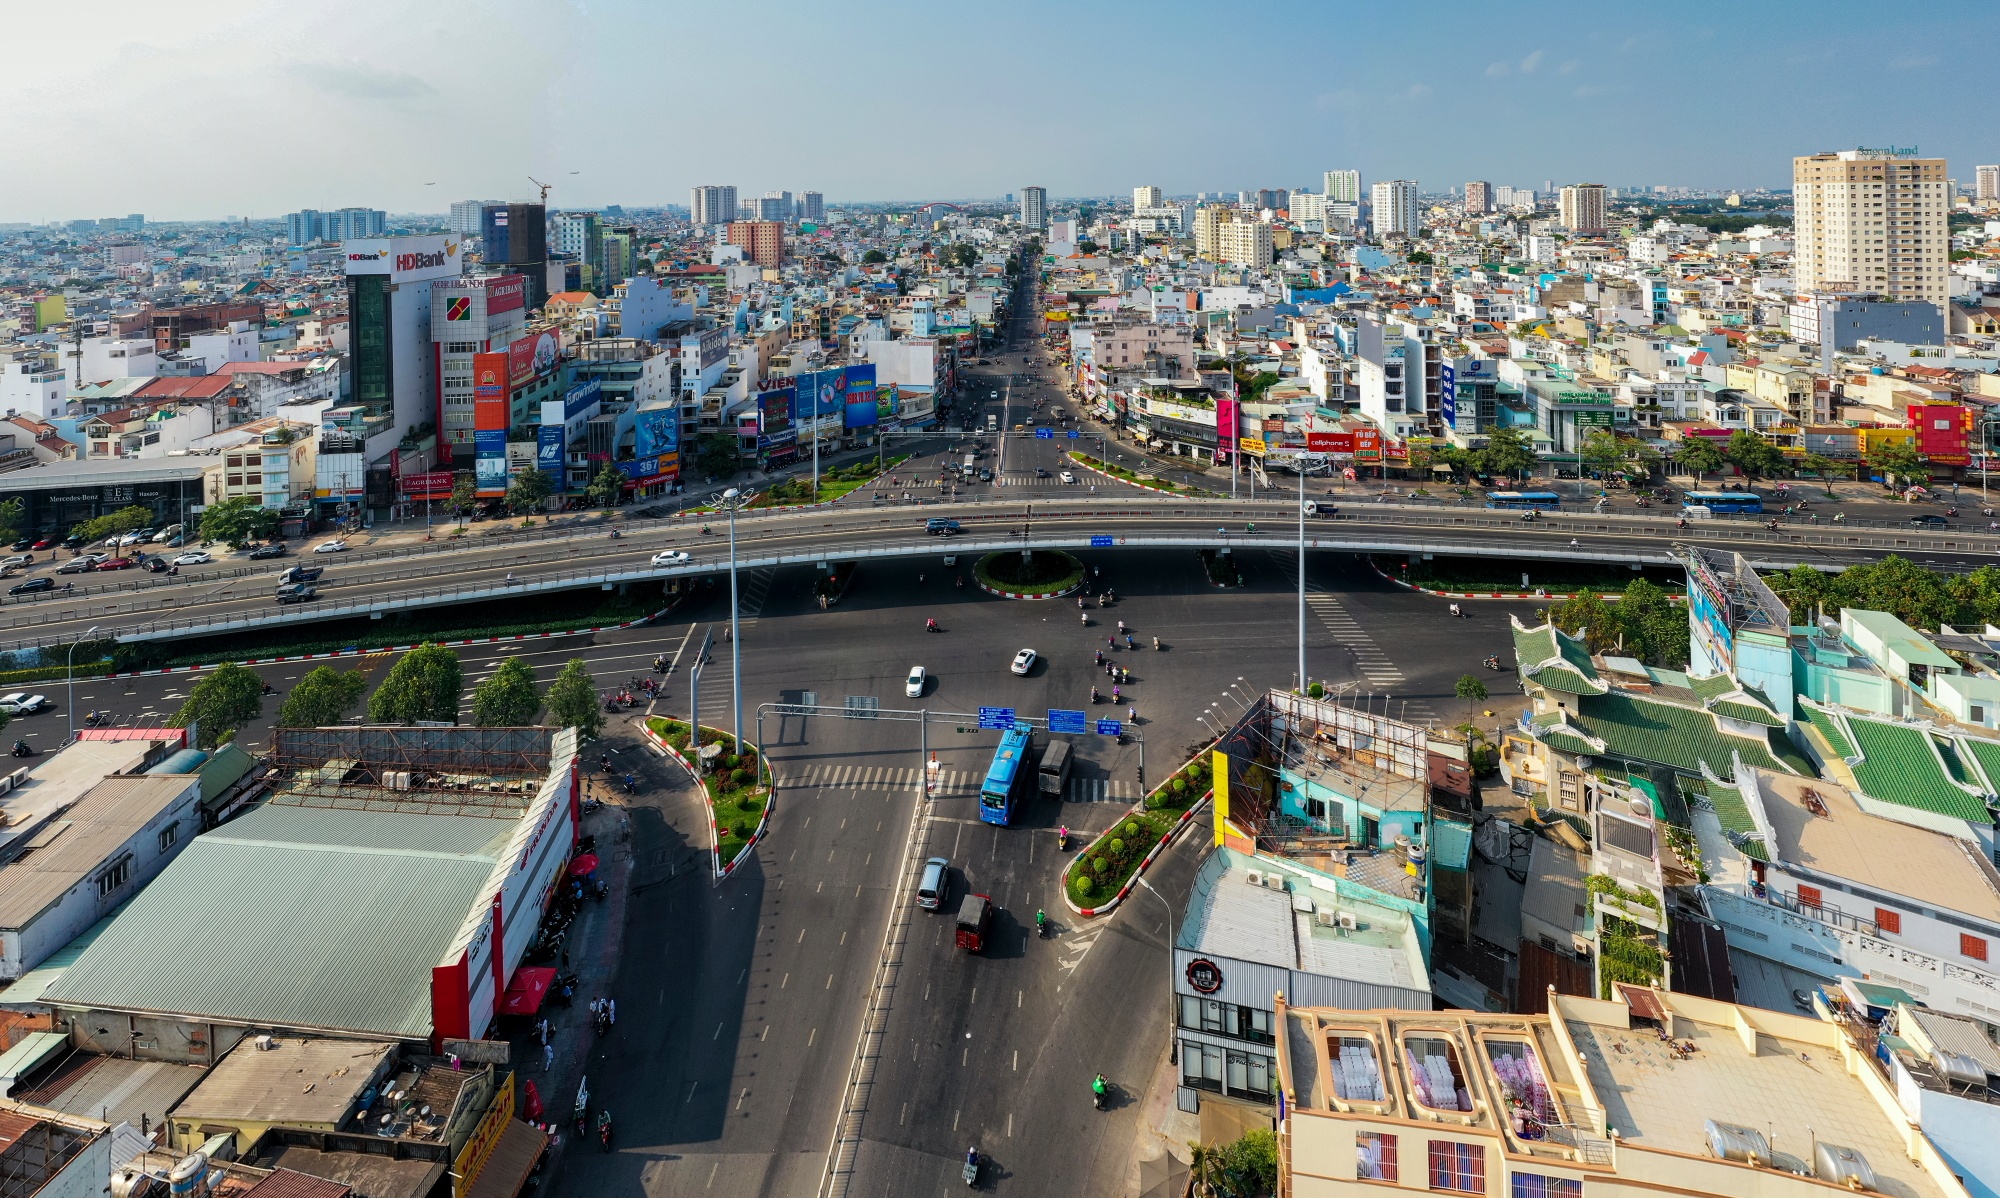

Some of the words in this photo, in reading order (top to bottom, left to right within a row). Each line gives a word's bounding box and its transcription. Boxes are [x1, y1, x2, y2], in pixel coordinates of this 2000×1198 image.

[1891, 145, 1918, 155] Land
[349, 253, 379, 261] HDBank
[396, 250, 445, 272] HDBank
[494, 282, 523, 297] AGRIBANK
[702, 336, 722, 354] Aikido
[566, 379, 600, 406] Eurowindow
[639, 459, 659, 473] 367
[411, 478, 447, 486] AGRIBANK
[115, 487, 122, 497] E
[49, 494, 98, 503] Mercedes-Benz
[1235, 1058, 1266, 1069] FACTORY
